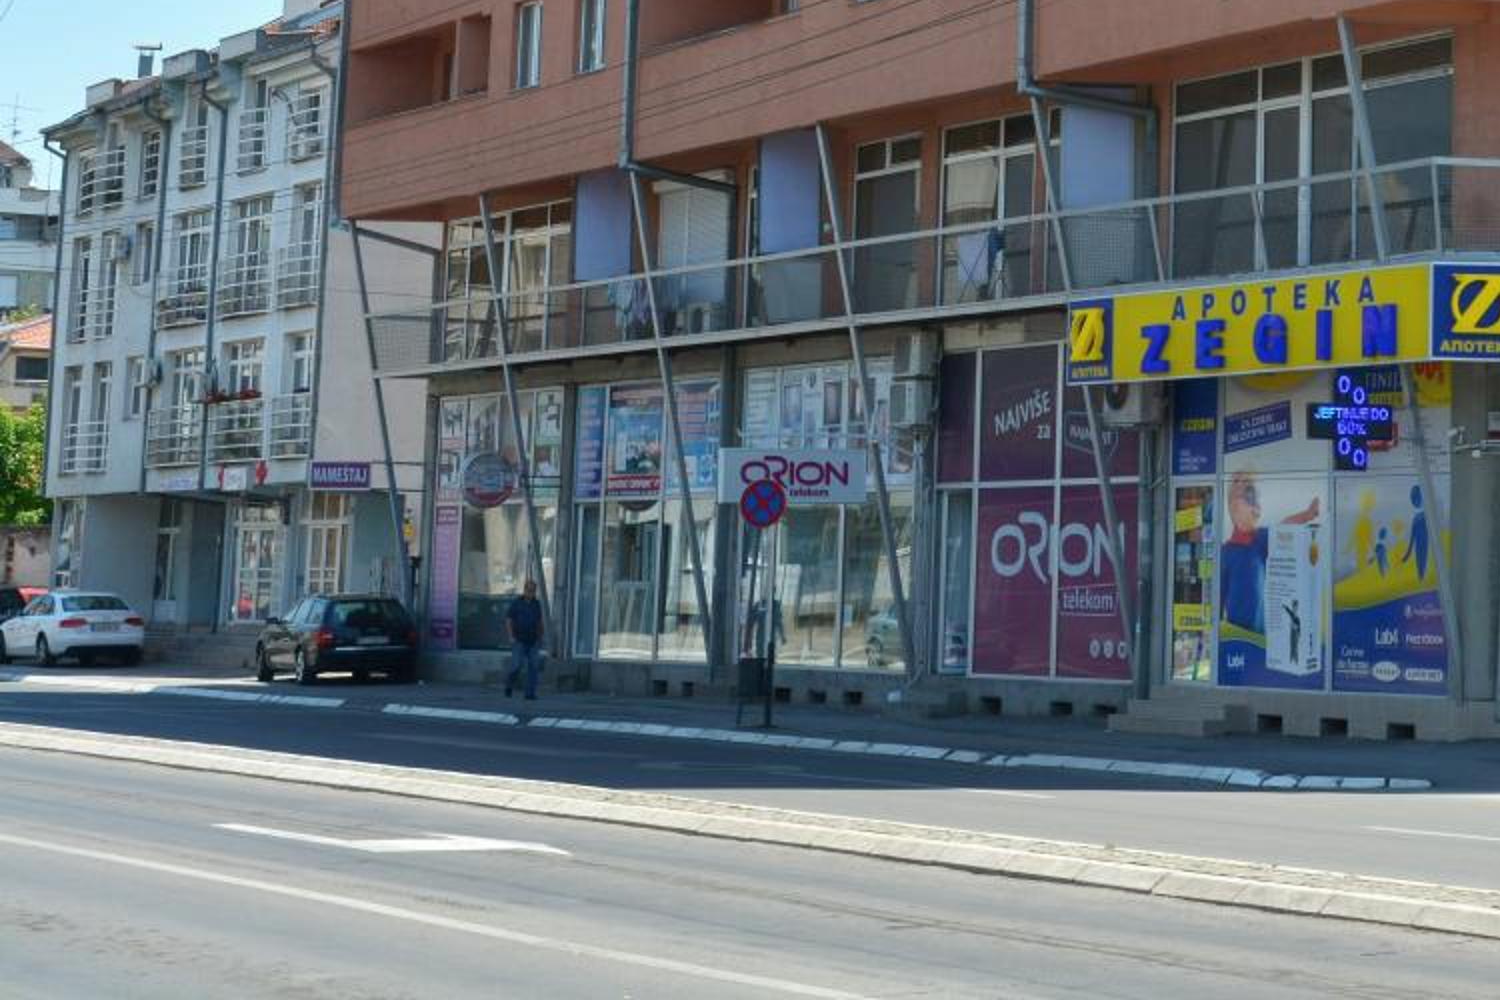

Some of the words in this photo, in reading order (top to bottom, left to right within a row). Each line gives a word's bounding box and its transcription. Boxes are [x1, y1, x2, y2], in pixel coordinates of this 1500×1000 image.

[1171, 276, 1375, 321] APOTEKA
[1140, 303, 1398, 373] ZEGIN
[313, 463, 368, 483] NAMEŠTAJ
[740, 455, 849, 489] ORION
[992, 511, 1126, 585] ORION
[1063, 587, 1114, 611] telekom
